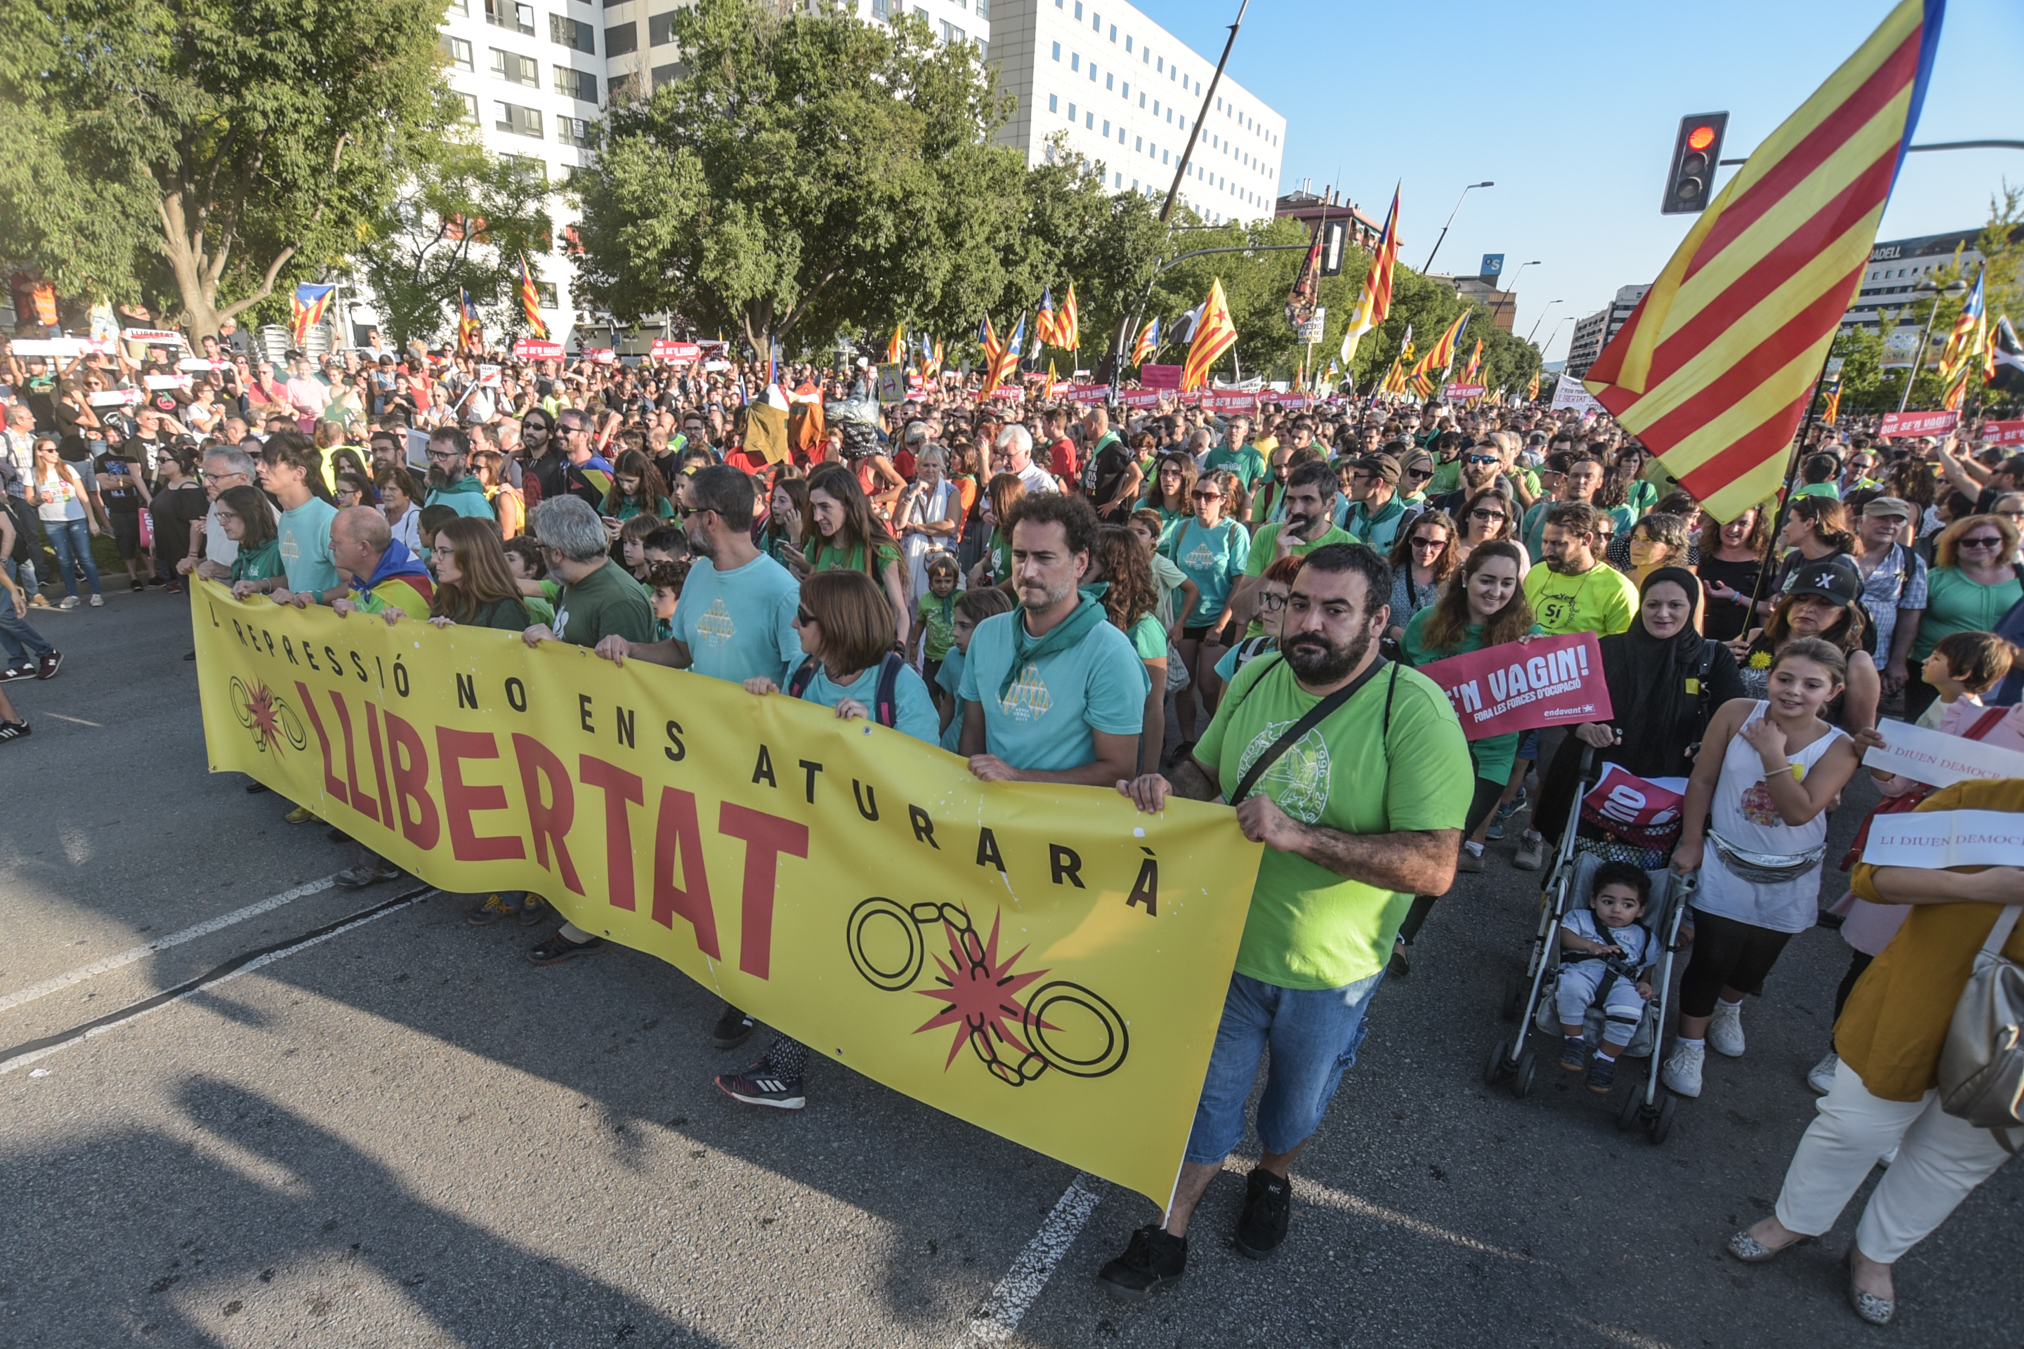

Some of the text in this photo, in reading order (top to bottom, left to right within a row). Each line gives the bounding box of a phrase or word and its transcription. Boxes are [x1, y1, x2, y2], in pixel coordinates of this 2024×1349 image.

[1881, 423, 1899, 435] QUE
[1488, 644, 1589, 702] VAGIN!
[1474, 676, 1582, 723] FORA LES FORCES D'OCUPACIÓ
[1544, 706, 1582, 717] endavant
[232, 618, 410, 697] REPRESSIÓ
[456, 672, 527, 712] NO
[578, 693, 686, 762] ENS
[752, 744, 1159, 917] ATURARÀ
[1895, 747, 1938, 764] DIUEN
[1939, 759, 2010, 780] DEMOCR
[294, 680, 809, 981] LLIBERTAT
[1880, 836, 1895, 845] LI
[1900, 836, 1950, 847] DIUEN
